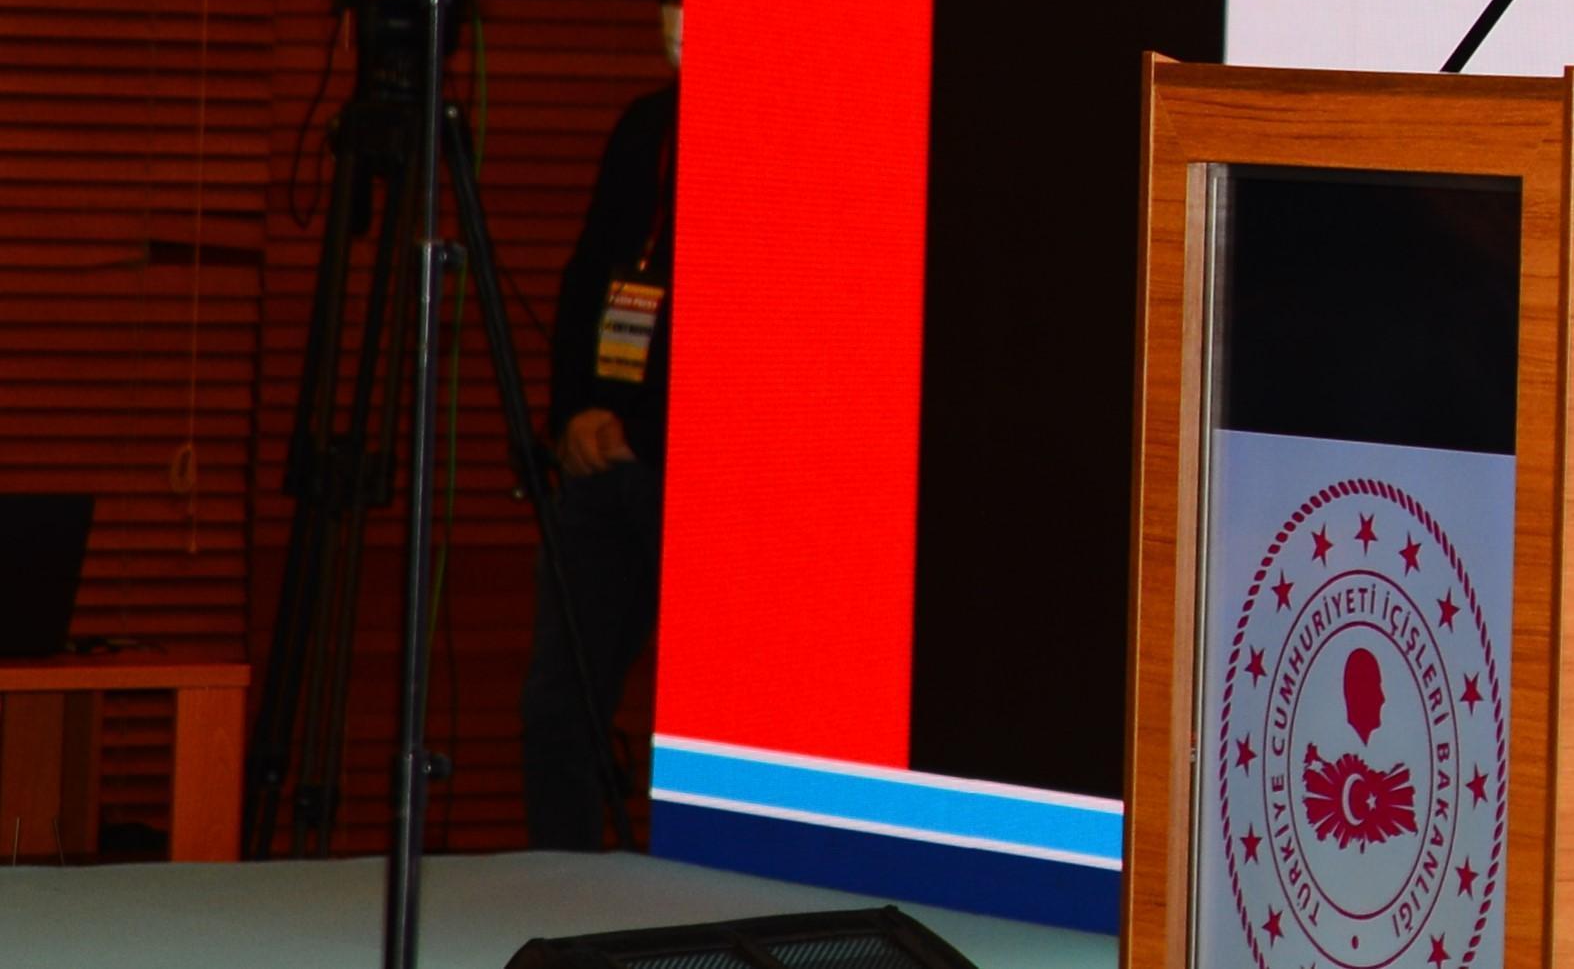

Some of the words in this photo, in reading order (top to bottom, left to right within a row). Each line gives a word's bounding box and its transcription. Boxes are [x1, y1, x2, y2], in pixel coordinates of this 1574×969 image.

[1271, 583, 1377, 757] CUMHURİYETİ
[1382, 590, 1450, 726] İÇİŞLERİ
[1392, 742, 1451, 938] BAKANLIĞI
